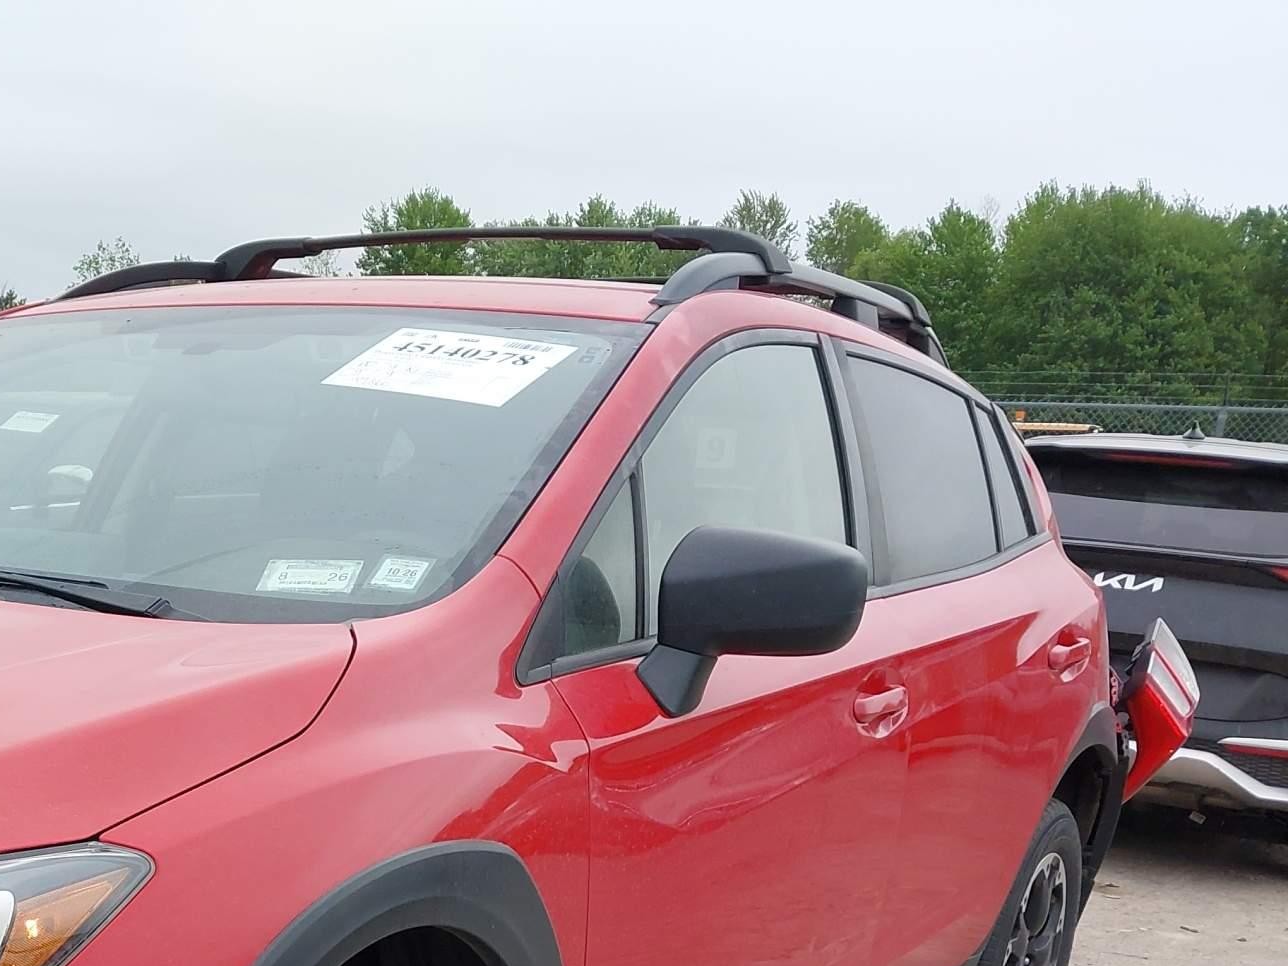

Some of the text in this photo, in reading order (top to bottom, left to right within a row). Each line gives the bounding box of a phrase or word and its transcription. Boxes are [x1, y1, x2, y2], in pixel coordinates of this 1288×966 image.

[393, 341, 536, 366] 45140278
[328, 572, 349, 582] 26
[1093, 571, 1164, 592] KIA
